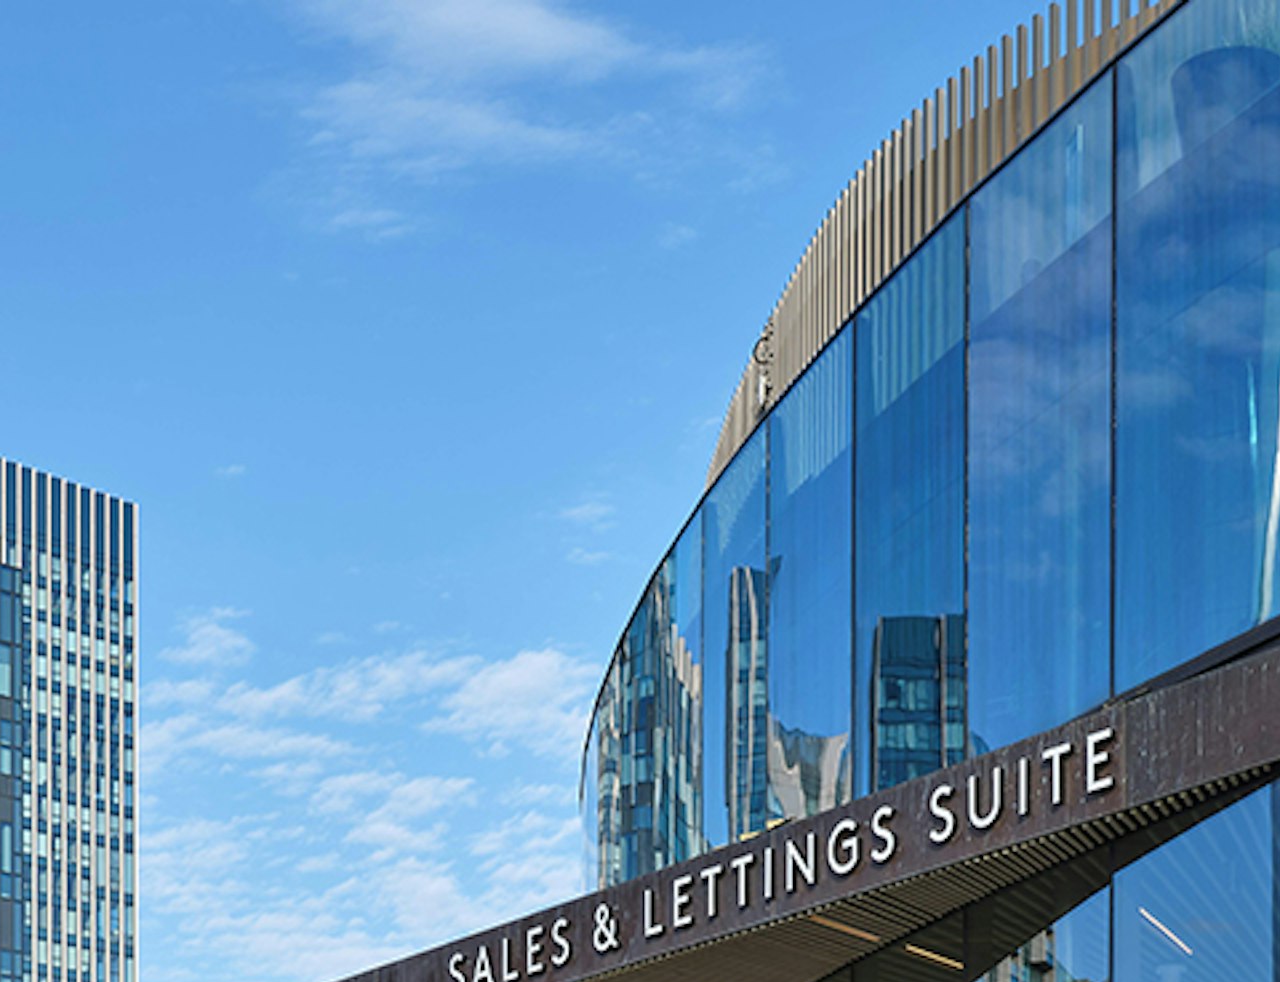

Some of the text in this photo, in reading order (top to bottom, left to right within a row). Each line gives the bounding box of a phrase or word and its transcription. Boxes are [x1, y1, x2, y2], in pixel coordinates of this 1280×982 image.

[591, 902, 621, 953] &
[643, 806, 898, 939] LETTINGS
[928, 727, 1115, 843] SUITE
